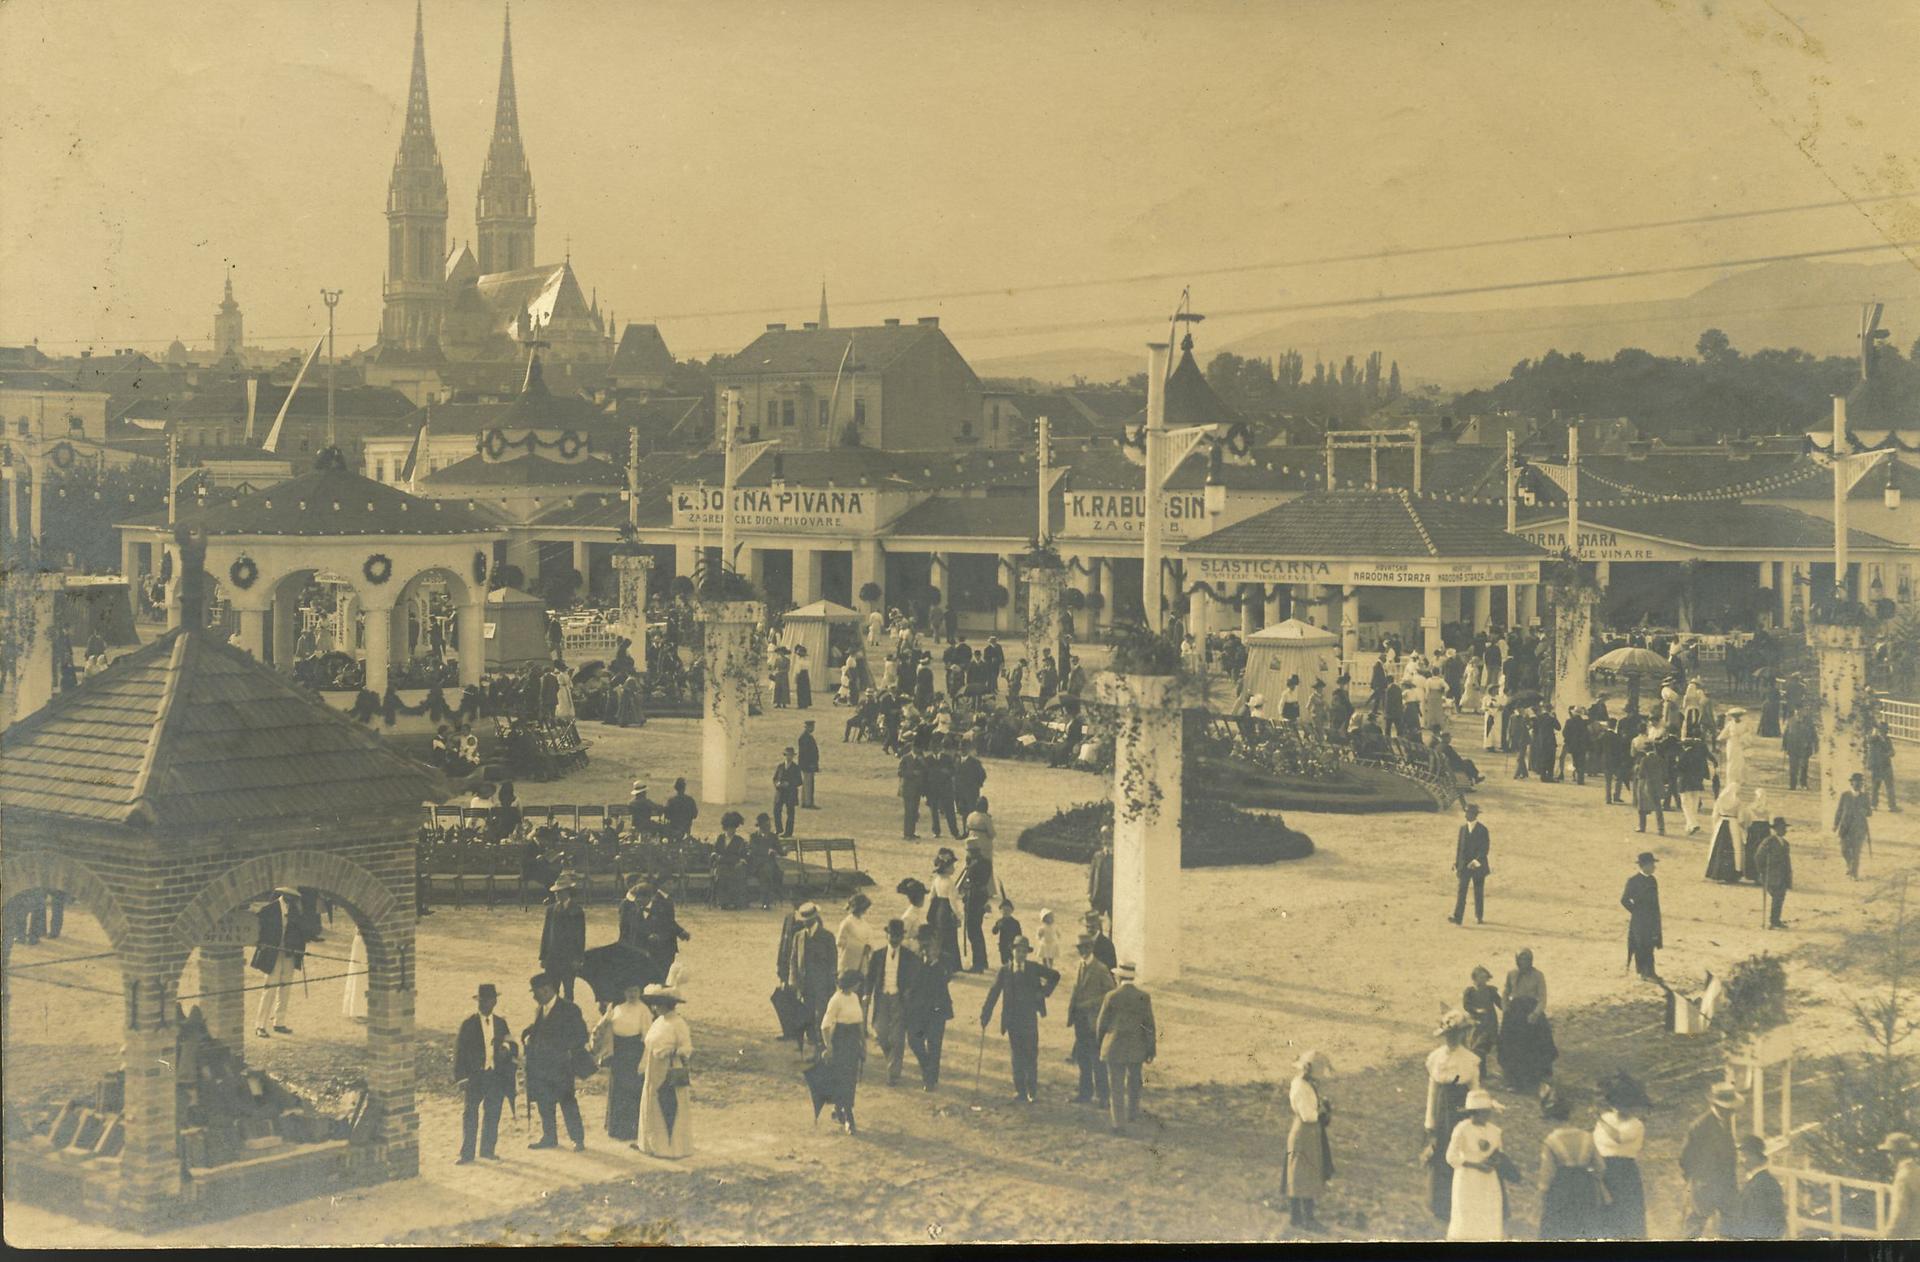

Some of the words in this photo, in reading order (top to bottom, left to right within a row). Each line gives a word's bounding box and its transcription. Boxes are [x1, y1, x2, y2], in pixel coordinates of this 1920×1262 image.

[778, 492, 862, 514] PIVANA
[784, 516, 841, 527] PIVOVARE
[1601, 549, 1654, 559] VINARE
[1353, 572, 1394, 581] NARODNA
